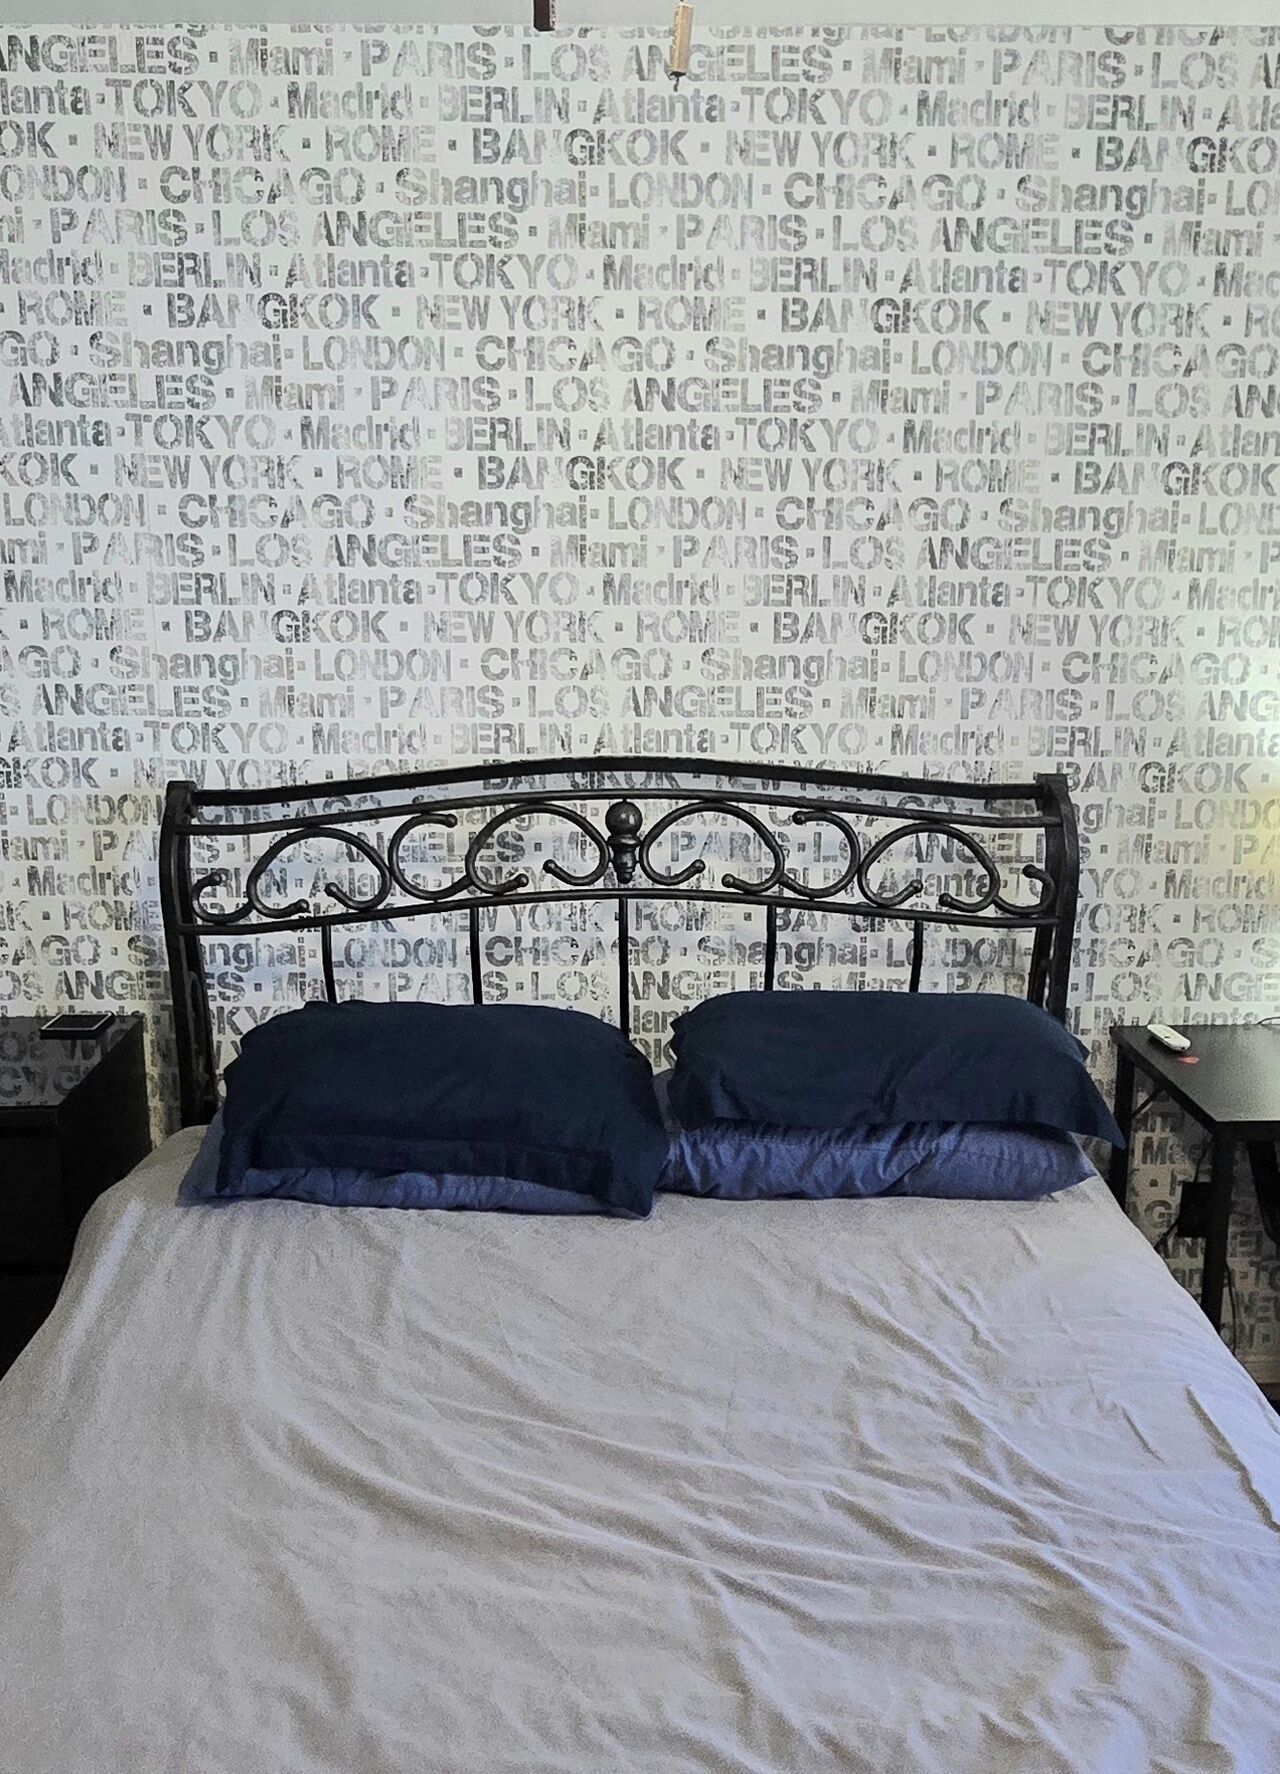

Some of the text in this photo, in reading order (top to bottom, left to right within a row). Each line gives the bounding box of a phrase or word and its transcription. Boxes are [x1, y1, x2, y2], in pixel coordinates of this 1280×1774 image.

[230, 37, 333, 76] Miami
[360, 39, 497, 79] PARIS
[522, 43, 611, 82] LOS
[862, 47, 966, 85] Miami
[992, 48, 1127, 86] PARIS
[1151, 51, 1239, 90] LOS
[105, 78, 262, 118] TOKYO
[286, 81, 412, 119] Madrid
[441, 85, 570, 123] BERLIN
[592, 87, 726, 124] Atlanta
[738, 86, 891, 125] TOKYO
[916, 90, 1040, 127] Madrid
[1067, 94, 1196, 131] BERLIN
[159, 166, 365, 205] CHICAGO
[395, 170, 587, 214] Shanghai
[608, 171, 754, 209] LONDON
[783, 172, 987, 211] CHICAGO
[1015, 178, 1210, 223] Shanghai
[17, 290, 127, 326] ROME
[167, 292, 379, 329] BANGKOK
[416, 294, 491, 331] NEW
[499, 295, 604, 331] YORK
[637, 295, 745, 332] ROME
[781, 297, 990, 334] BANGKOK
[1026, 300, 1102, 337] NEW
[1110, 302, 1211, 338] YORK
[89, 333, 282, 377] Shanghai
[302, 335, 445, 371] LONDON
[475, 335, 675, 372] CHICAGO
[704, 338, 891, 380] Shanghai
[911, 340, 1053, 376] LONDON
[1082, 342, 1279, 378] CHICAGO
[126, 413, 276, 450] TOKYO
[300, 415, 420, 450] Madrid
[448, 416, 571, 452] BERLIN
[592, 417, 720, 452] Atlanta
[732, 417, 878, 453] TOKYO
[902, 419, 1021, 454] Madrid
[1047, 422, 1170, 457] BERLIN
[3, 492, 145, 527] LONDON
[178, 493, 375, 529] CHICAGO
[403, 494, 587, 536] Shanghai
[608, 496, 747, 531] LONDON
[775, 496, 970, 531] CHICAGO
[998, 500, 1184, 541] Shanghai
[72, 531, 205, 567] PARIS
[227, 533, 313, 568] LOS
[326, 533, 522, 568] ANGELES
[550, 534, 648, 568] Miami
[672, 535, 799, 569] PARIS
[822, 535, 905, 570] LOS
[919, 536, 1116, 571] ANGELES
[1138, 539, 1236, 573] Miami
[41, 607, 146, 641] ROME
[184, 609, 388, 643] BANGKOK
[423, 610, 495, 644] NEW
[504, 610, 603, 644] YORK
[636, 610, 740, 644] ROME
[773, 611, 974, 645] BANGKOK
[1008, 613, 1080, 647] NEW
[1089, 614, 1185, 648] YORK
[110, 647, 295, 687] Shanghai
[314, 648, 452, 682] LONDON
[480, 647, 673, 681] CHICAGO
[700, 648, 879, 688] Shanghai
[898, 650, 1034, 683] LONDON
[1061, 651, 1251, 685] CHICAGO
[7, 721, 131, 753] Atlanta
[143, 720, 289, 754] TOKYO
[311, 722, 427, 754] Madrid
[451, 722, 572, 754] BERLIN
[593, 723, 714, 753] Atlanta
[726, 722, 866, 754] TOKYO
[890, 723, 1005, 755] Madrid
[1029, 725, 1147, 758] BERLIN
[26, 794, 165, 826] LONDON
[531, 971, 608, 1001] LOS
